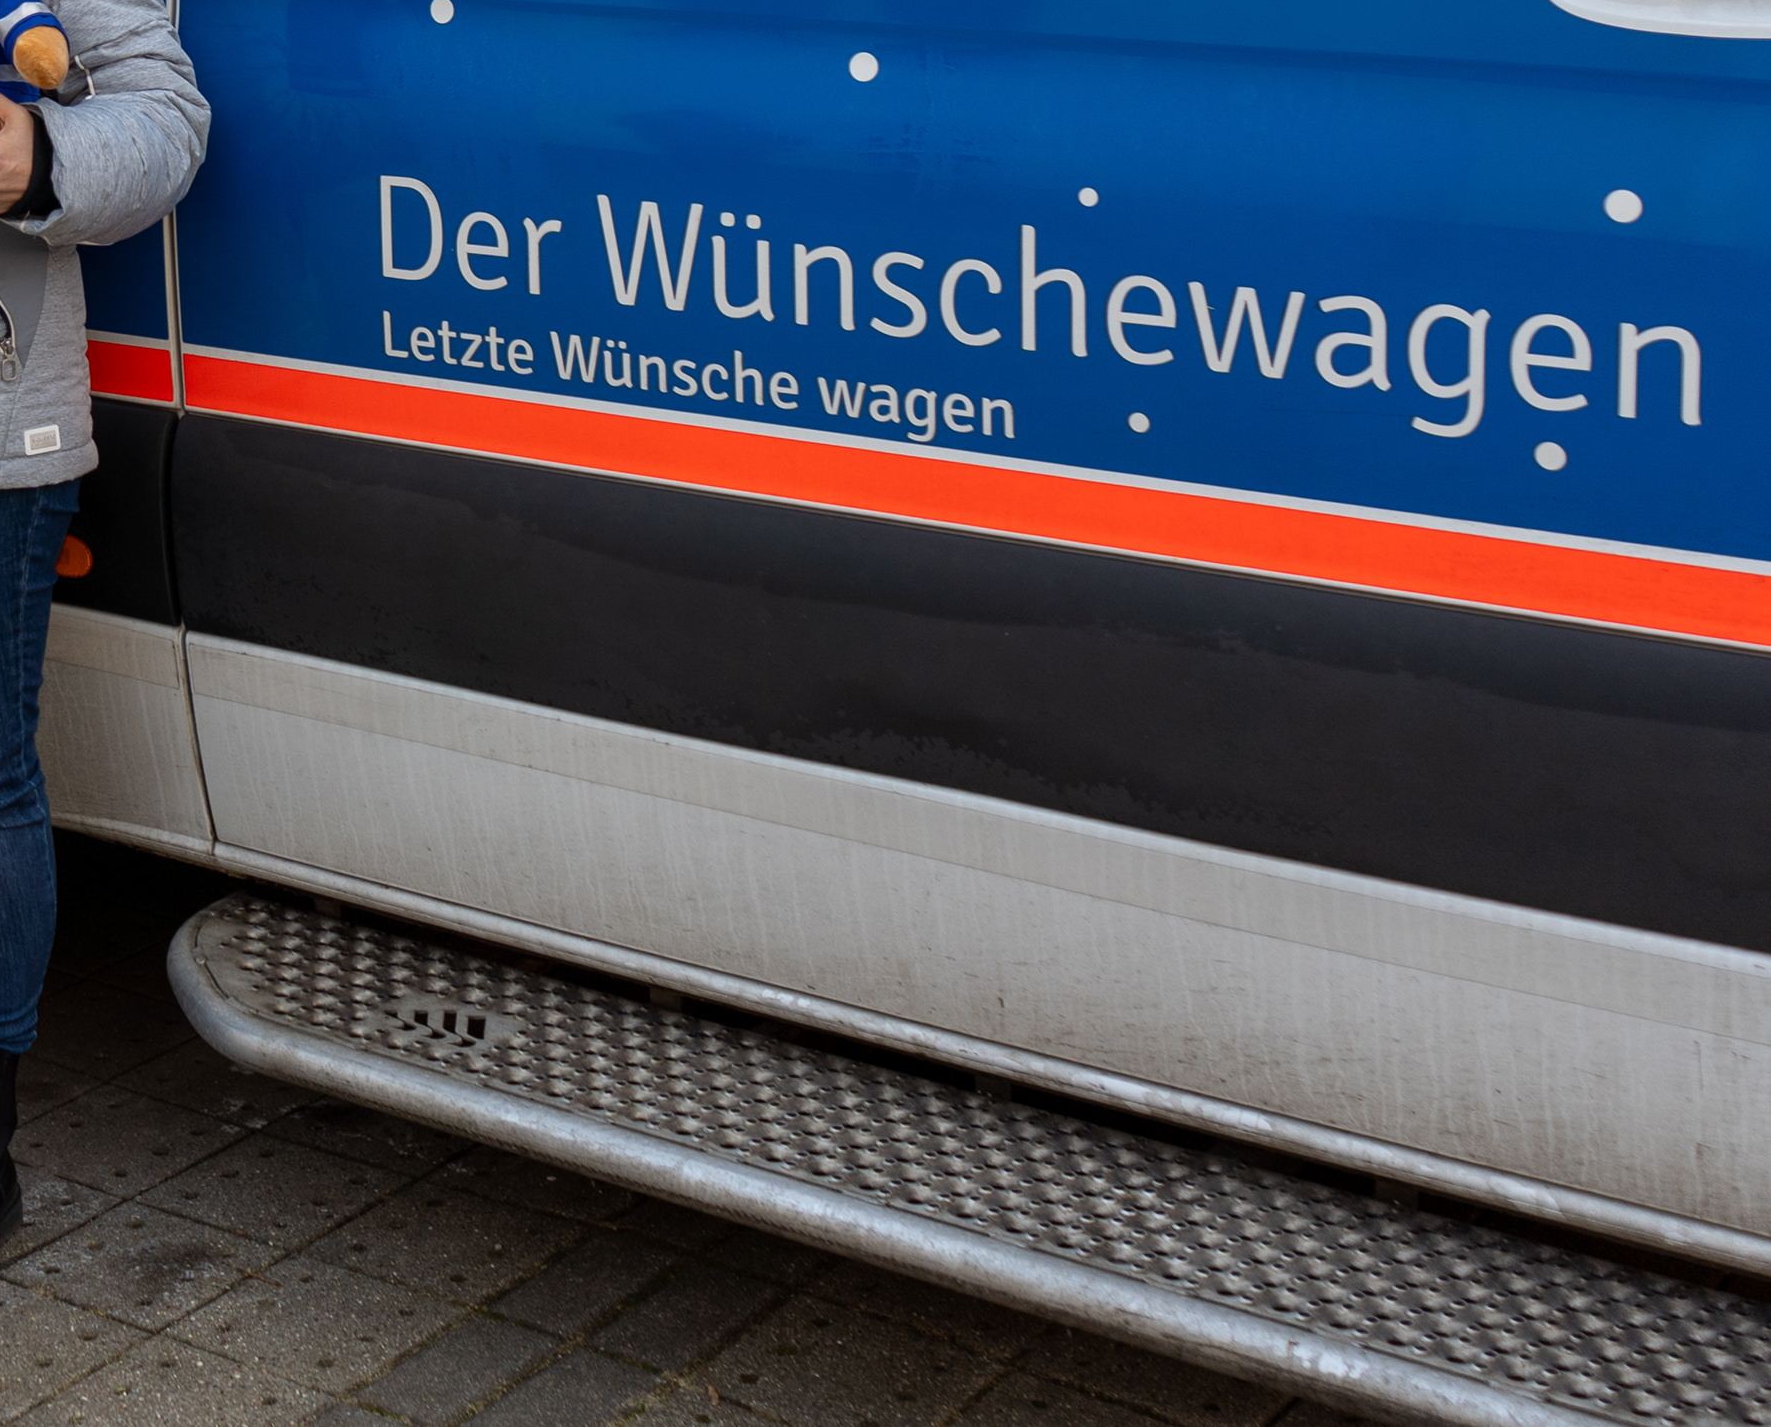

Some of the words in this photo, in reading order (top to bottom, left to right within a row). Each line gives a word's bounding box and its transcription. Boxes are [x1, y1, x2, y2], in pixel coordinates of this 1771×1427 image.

[379, 174, 563, 296] Der
[596, 193, 1703, 439] Wünschewagen
[381, 309, 535, 376] Letzte
[549, 330, 800, 412] Wünsche
[817, 376, 1016, 443] wagen
